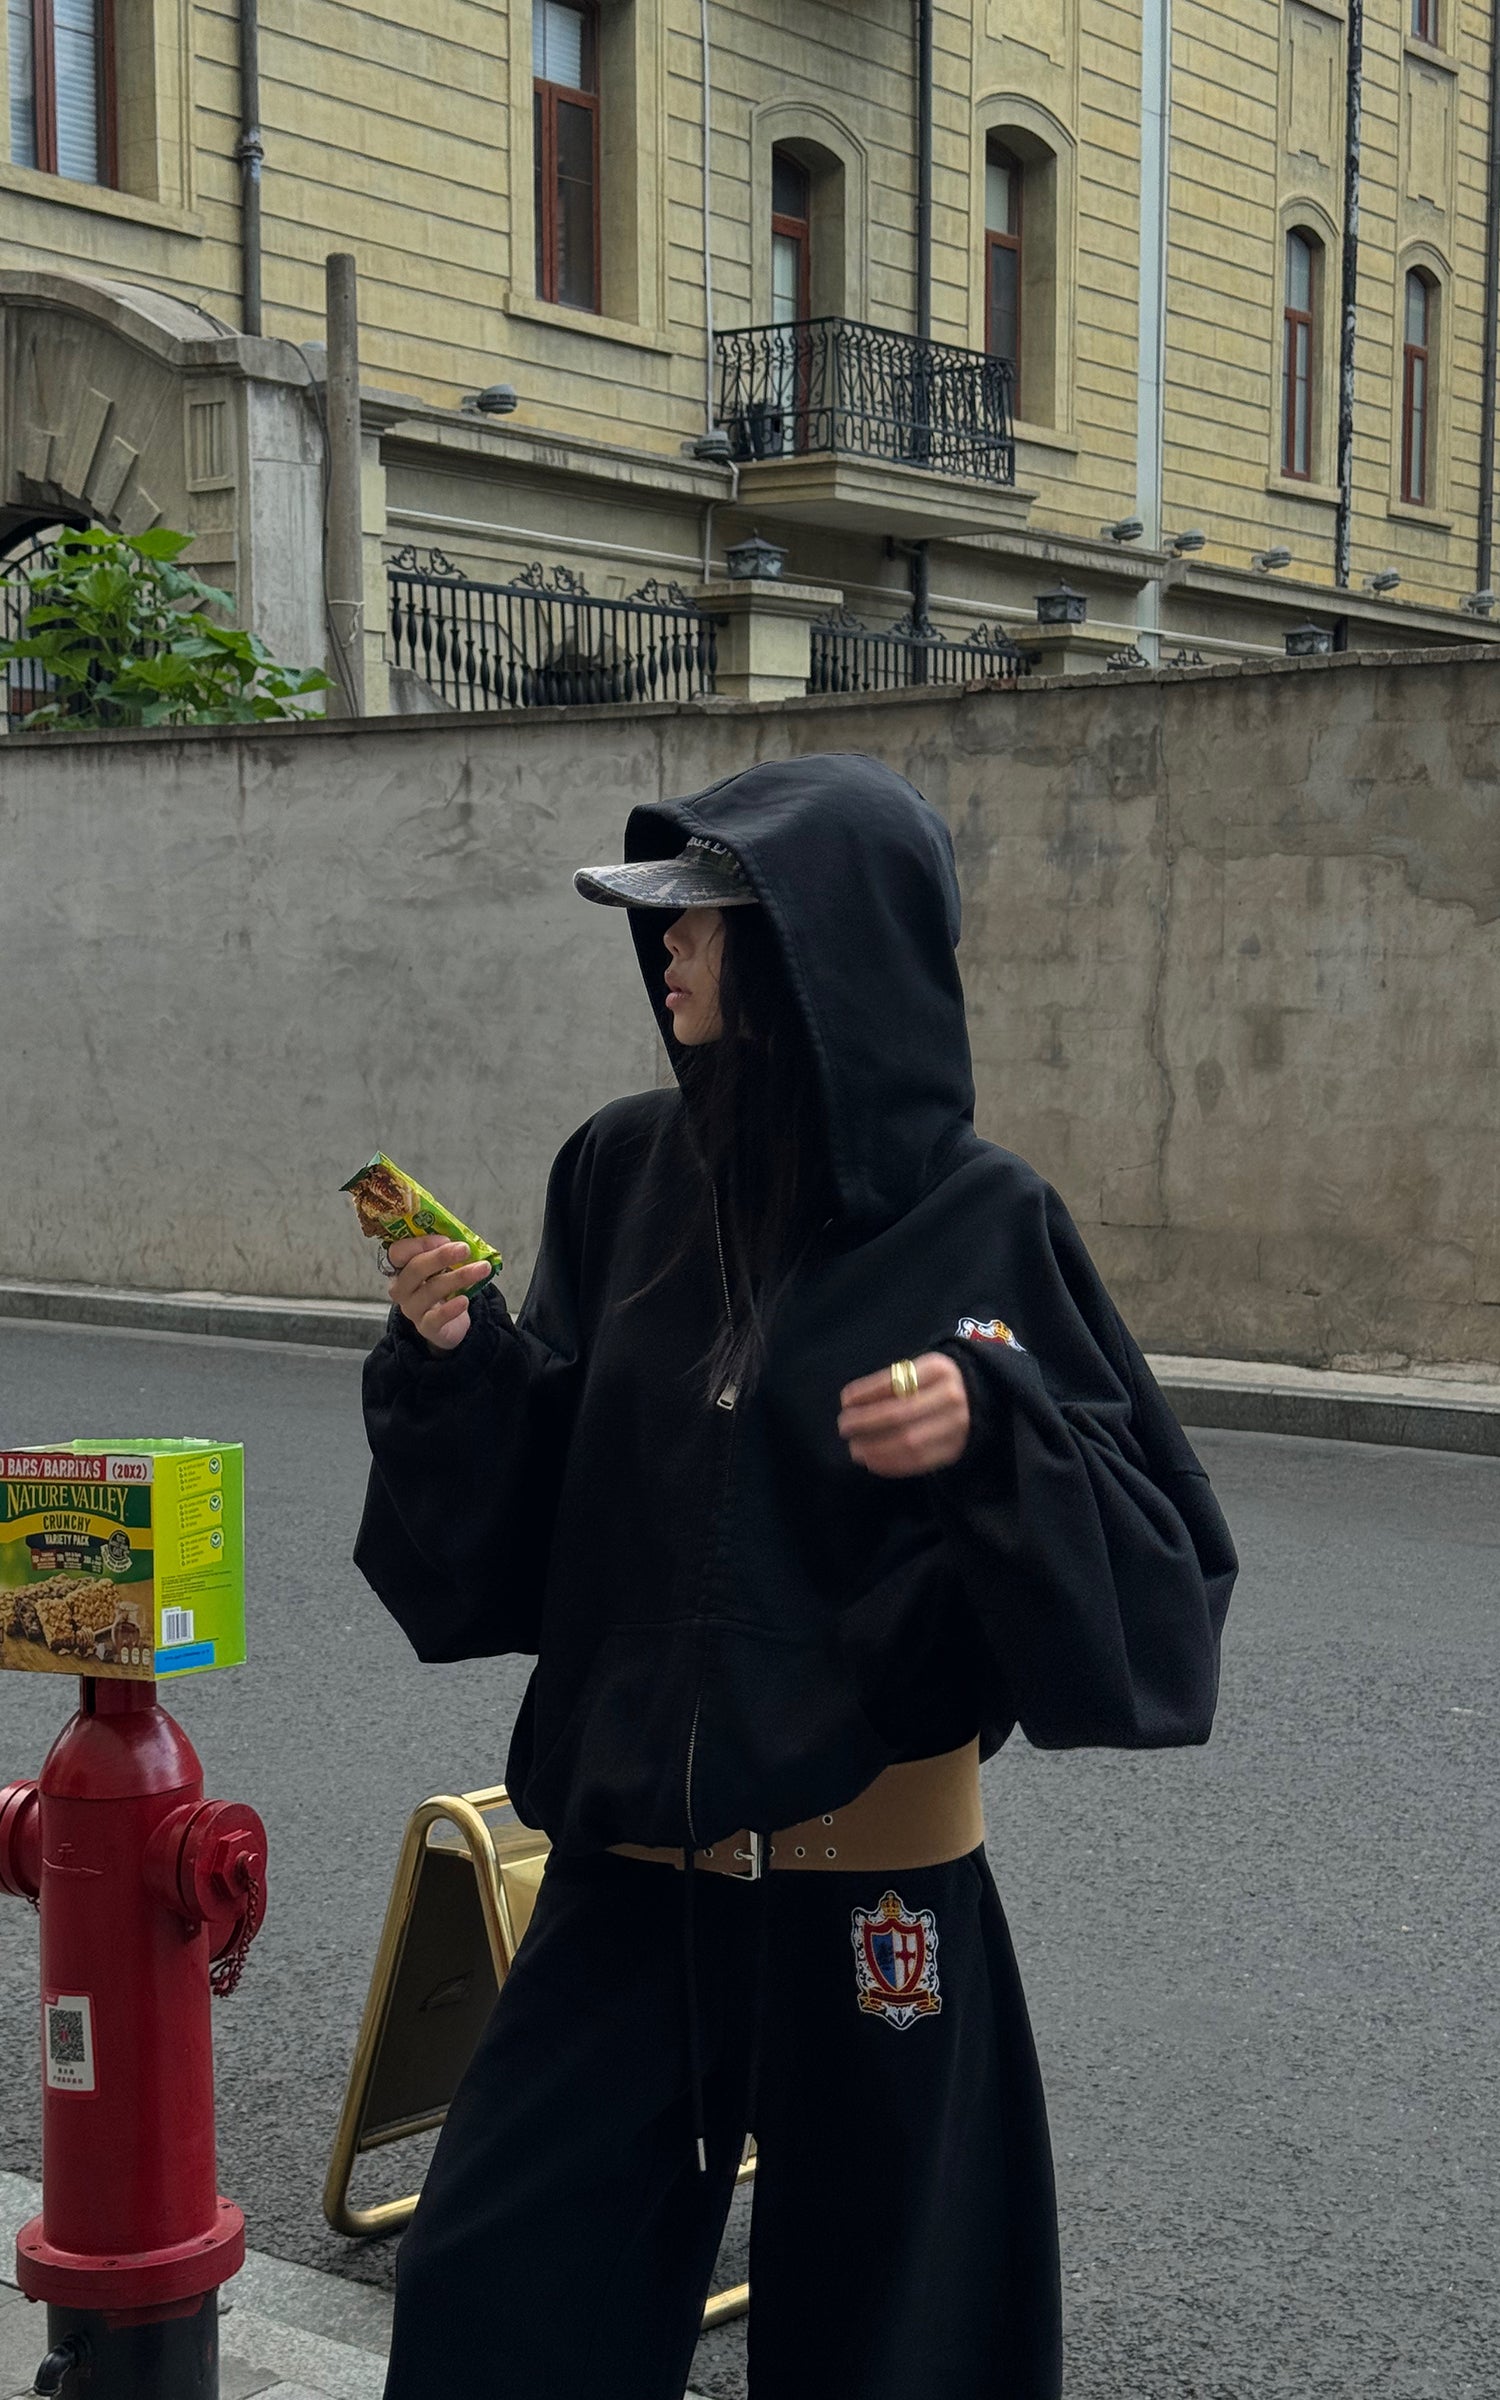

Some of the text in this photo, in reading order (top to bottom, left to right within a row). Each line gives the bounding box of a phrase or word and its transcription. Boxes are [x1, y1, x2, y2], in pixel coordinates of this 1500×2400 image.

[7, 1457, 101, 1478] BARS/BARRITAS
[112, 1462, 147, 1479] (20X2)
[7, 1483, 128, 1521] NATURE VALLEY
[43, 1514, 91, 1533] CRUNCHY
[44, 1534, 90, 1547] VARIETY PACK
